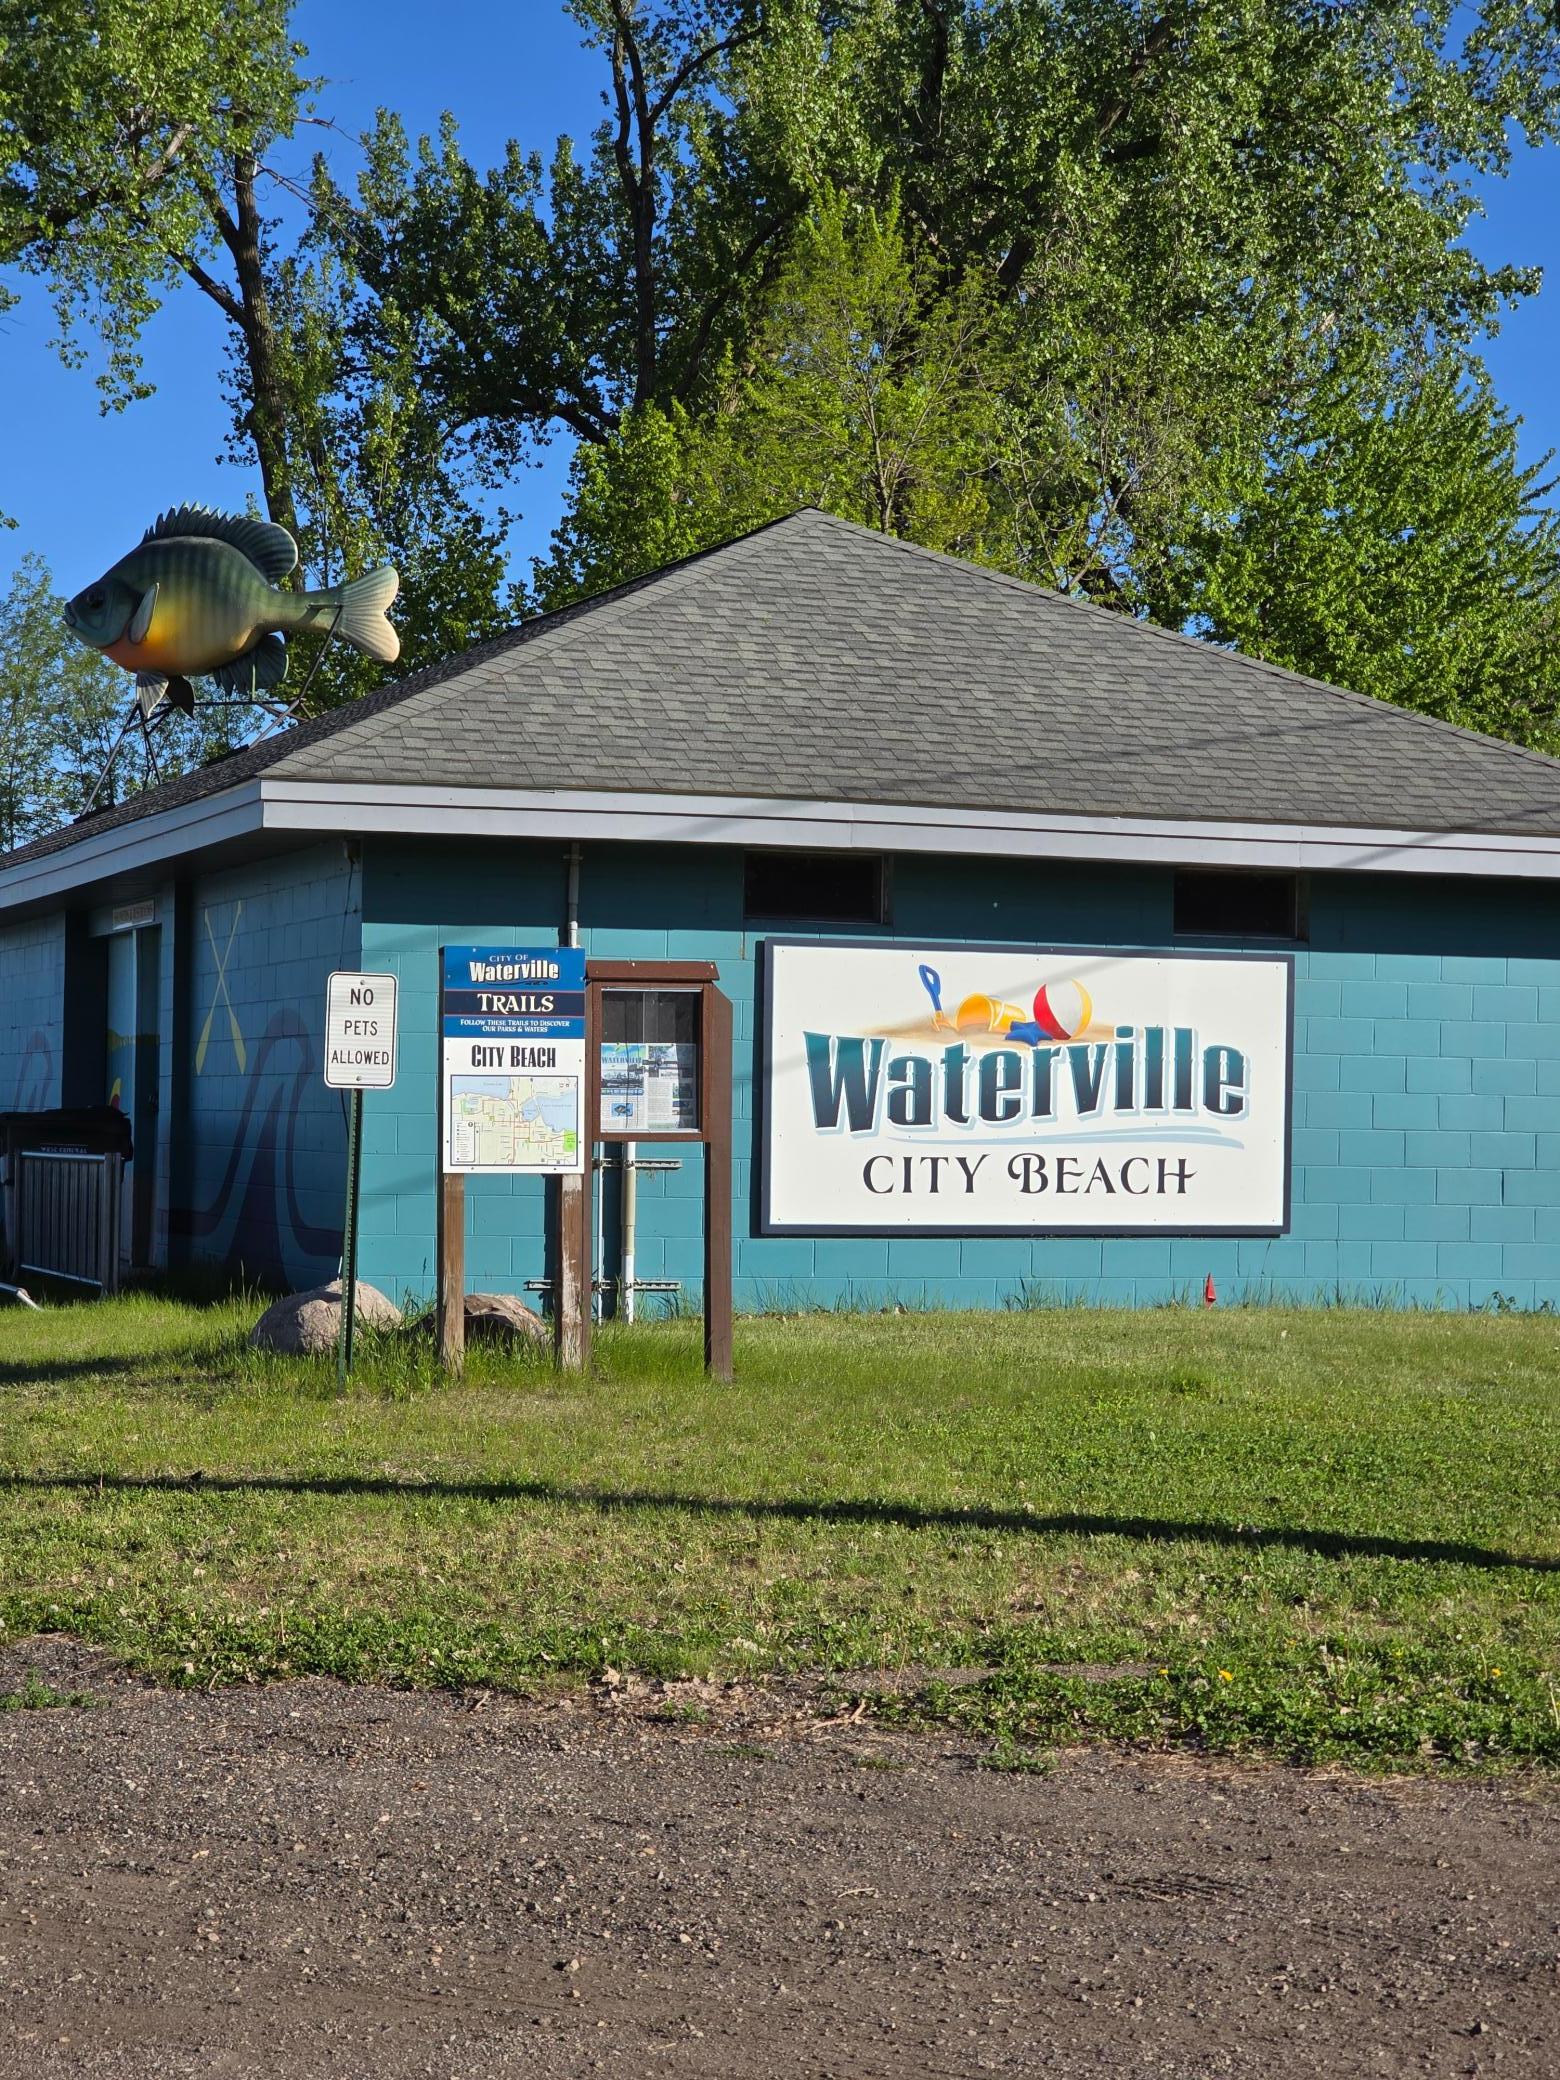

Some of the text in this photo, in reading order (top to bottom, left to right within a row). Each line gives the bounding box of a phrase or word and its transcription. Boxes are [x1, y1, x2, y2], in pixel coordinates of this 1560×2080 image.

[515, 953, 529, 961] OF
[469, 959, 559, 982] Waterville
[350, 988, 374, 1006] NO
[477, 993, 554, 1015] TRAILS
[344, 1020, 378, 1036] PETS
[460, 1018, 485, 1026] FOLLOW
[508, 1019, 529, 1027] TRAILS
[540, 1020, 570, 1028] DISCOVER
[482, 1025, 496, 1033] OUR
[497, 1025, 516, 1033] PARKS
[331, 1049, 389, 1065] ALLOWED
[471, 1044, 557, 1068] CITY BEACH
[802, 1024, 1251, 1134] Waterville
[862, 1153, 1198, 1195] CITY BEACH
